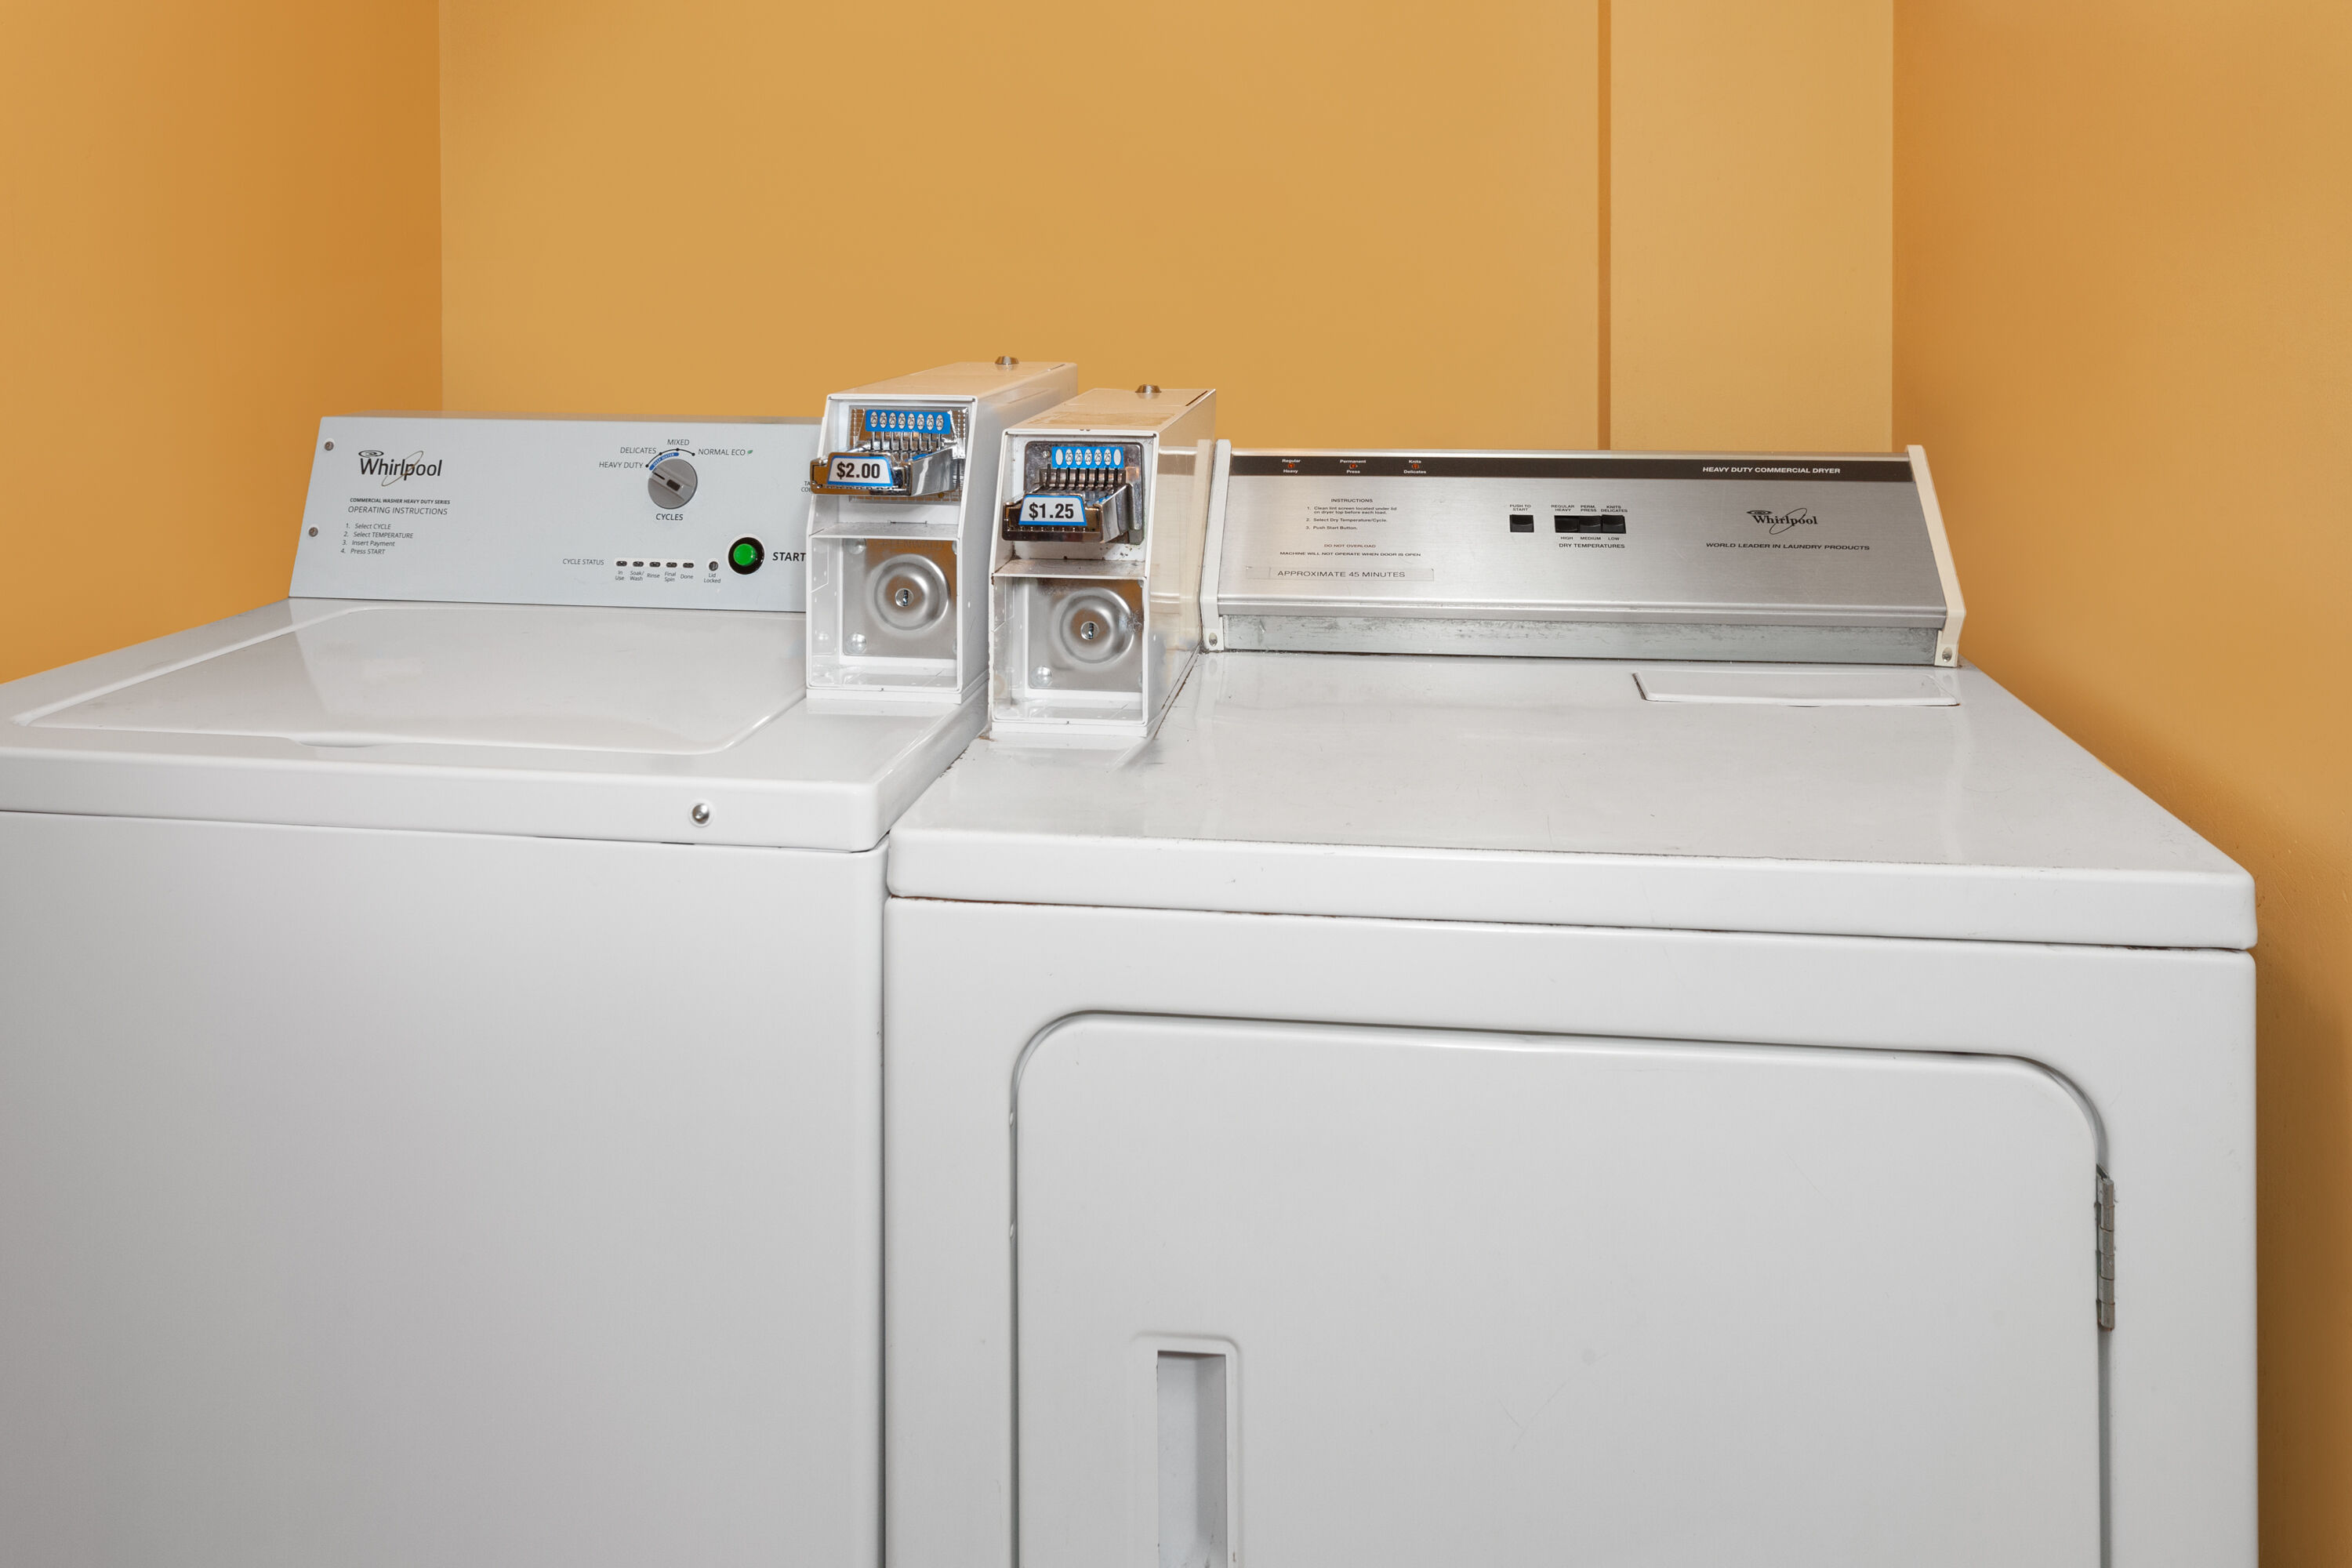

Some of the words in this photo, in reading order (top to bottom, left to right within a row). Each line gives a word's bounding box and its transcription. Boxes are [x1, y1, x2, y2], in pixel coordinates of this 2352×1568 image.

[361, 458, 442, 481] Whirlpool
[837, 462, 880, 480] $2.00
[393, 506, 448, 515] INSTRUCTIONS
[1029, 502, 1074, 521] $1.25
[1751, 514, 1818, 526] Whirlpool
[772, 552, 807, 561] START
